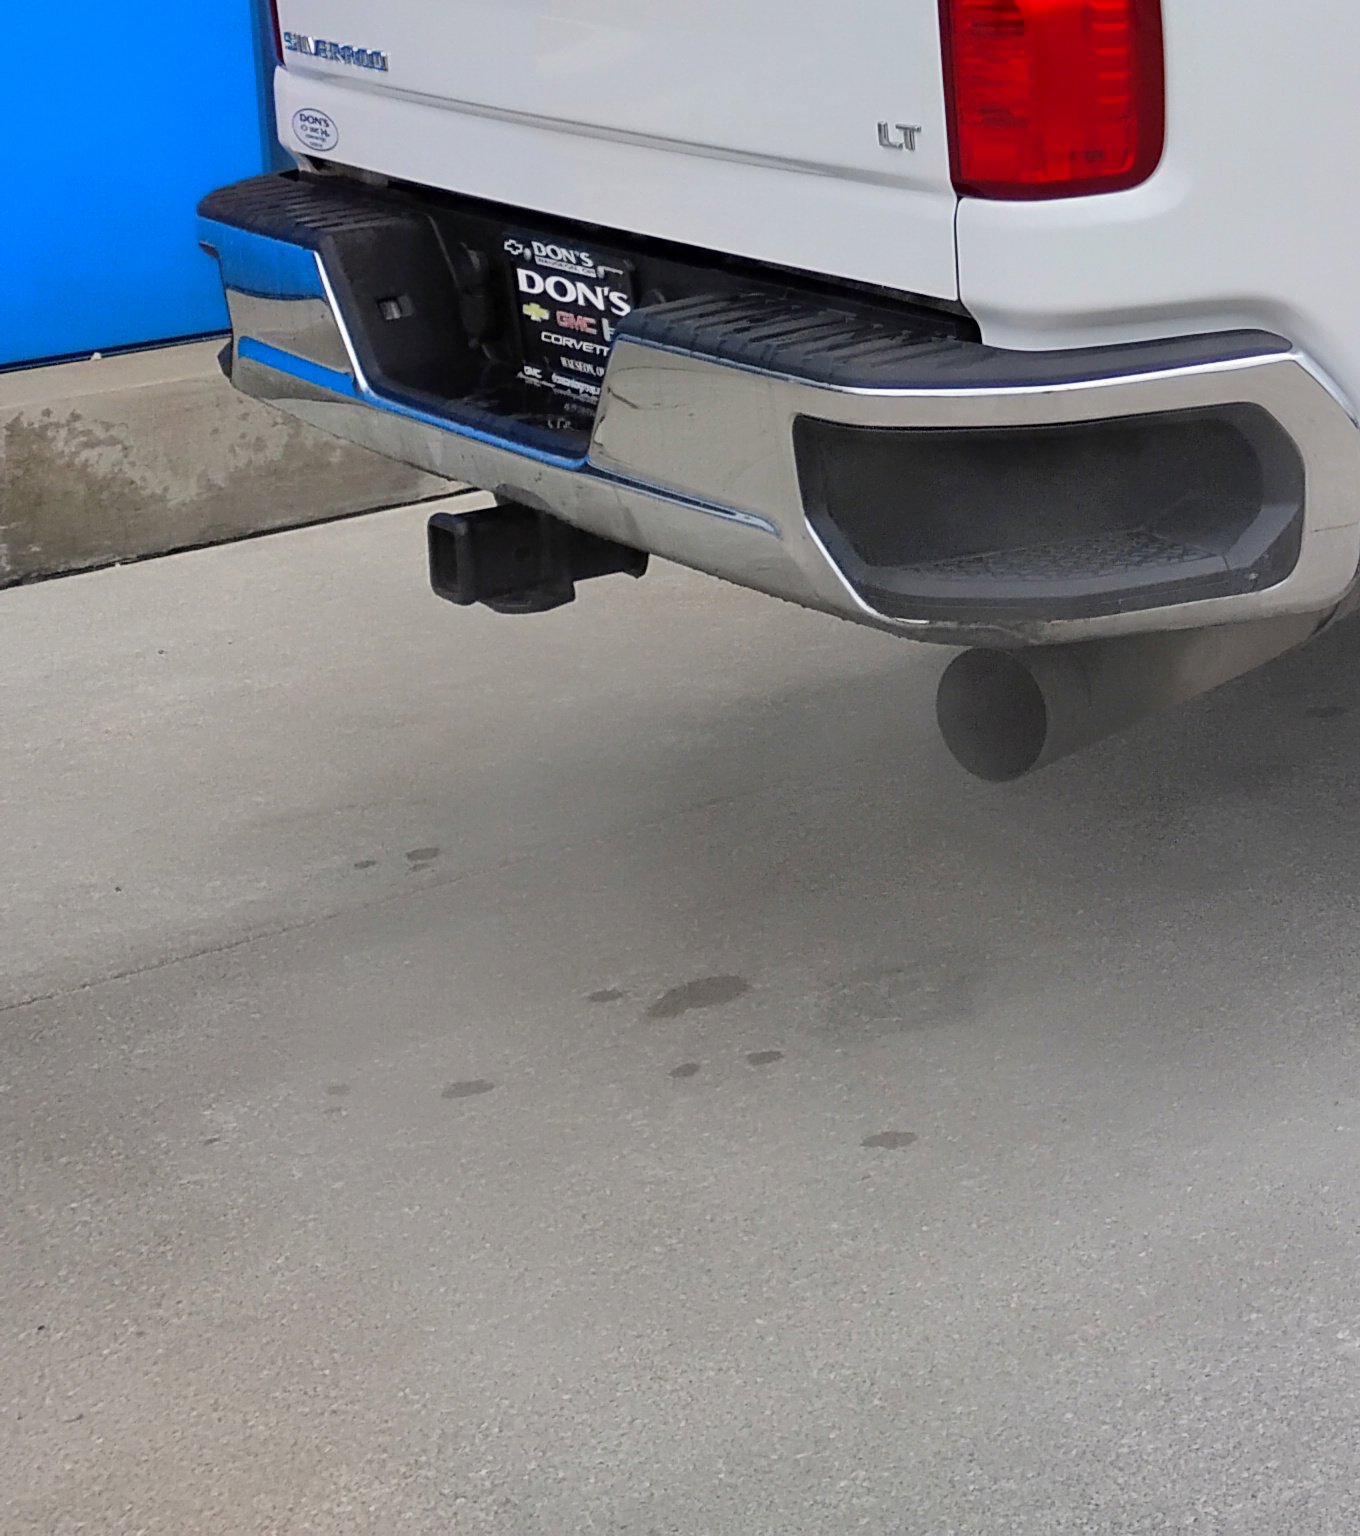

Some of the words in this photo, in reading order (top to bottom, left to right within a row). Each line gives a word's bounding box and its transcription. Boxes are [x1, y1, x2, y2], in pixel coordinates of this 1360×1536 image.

[299, 113, 330, 128] DON'S
[877, 121, 922, 151] LT
[531, 240, 594, 268] DON'S
[516, 267, 632, 316] DON'S
[555, 310, 598, 335] GMC
[541, 331, 611, 357] CORVETT
